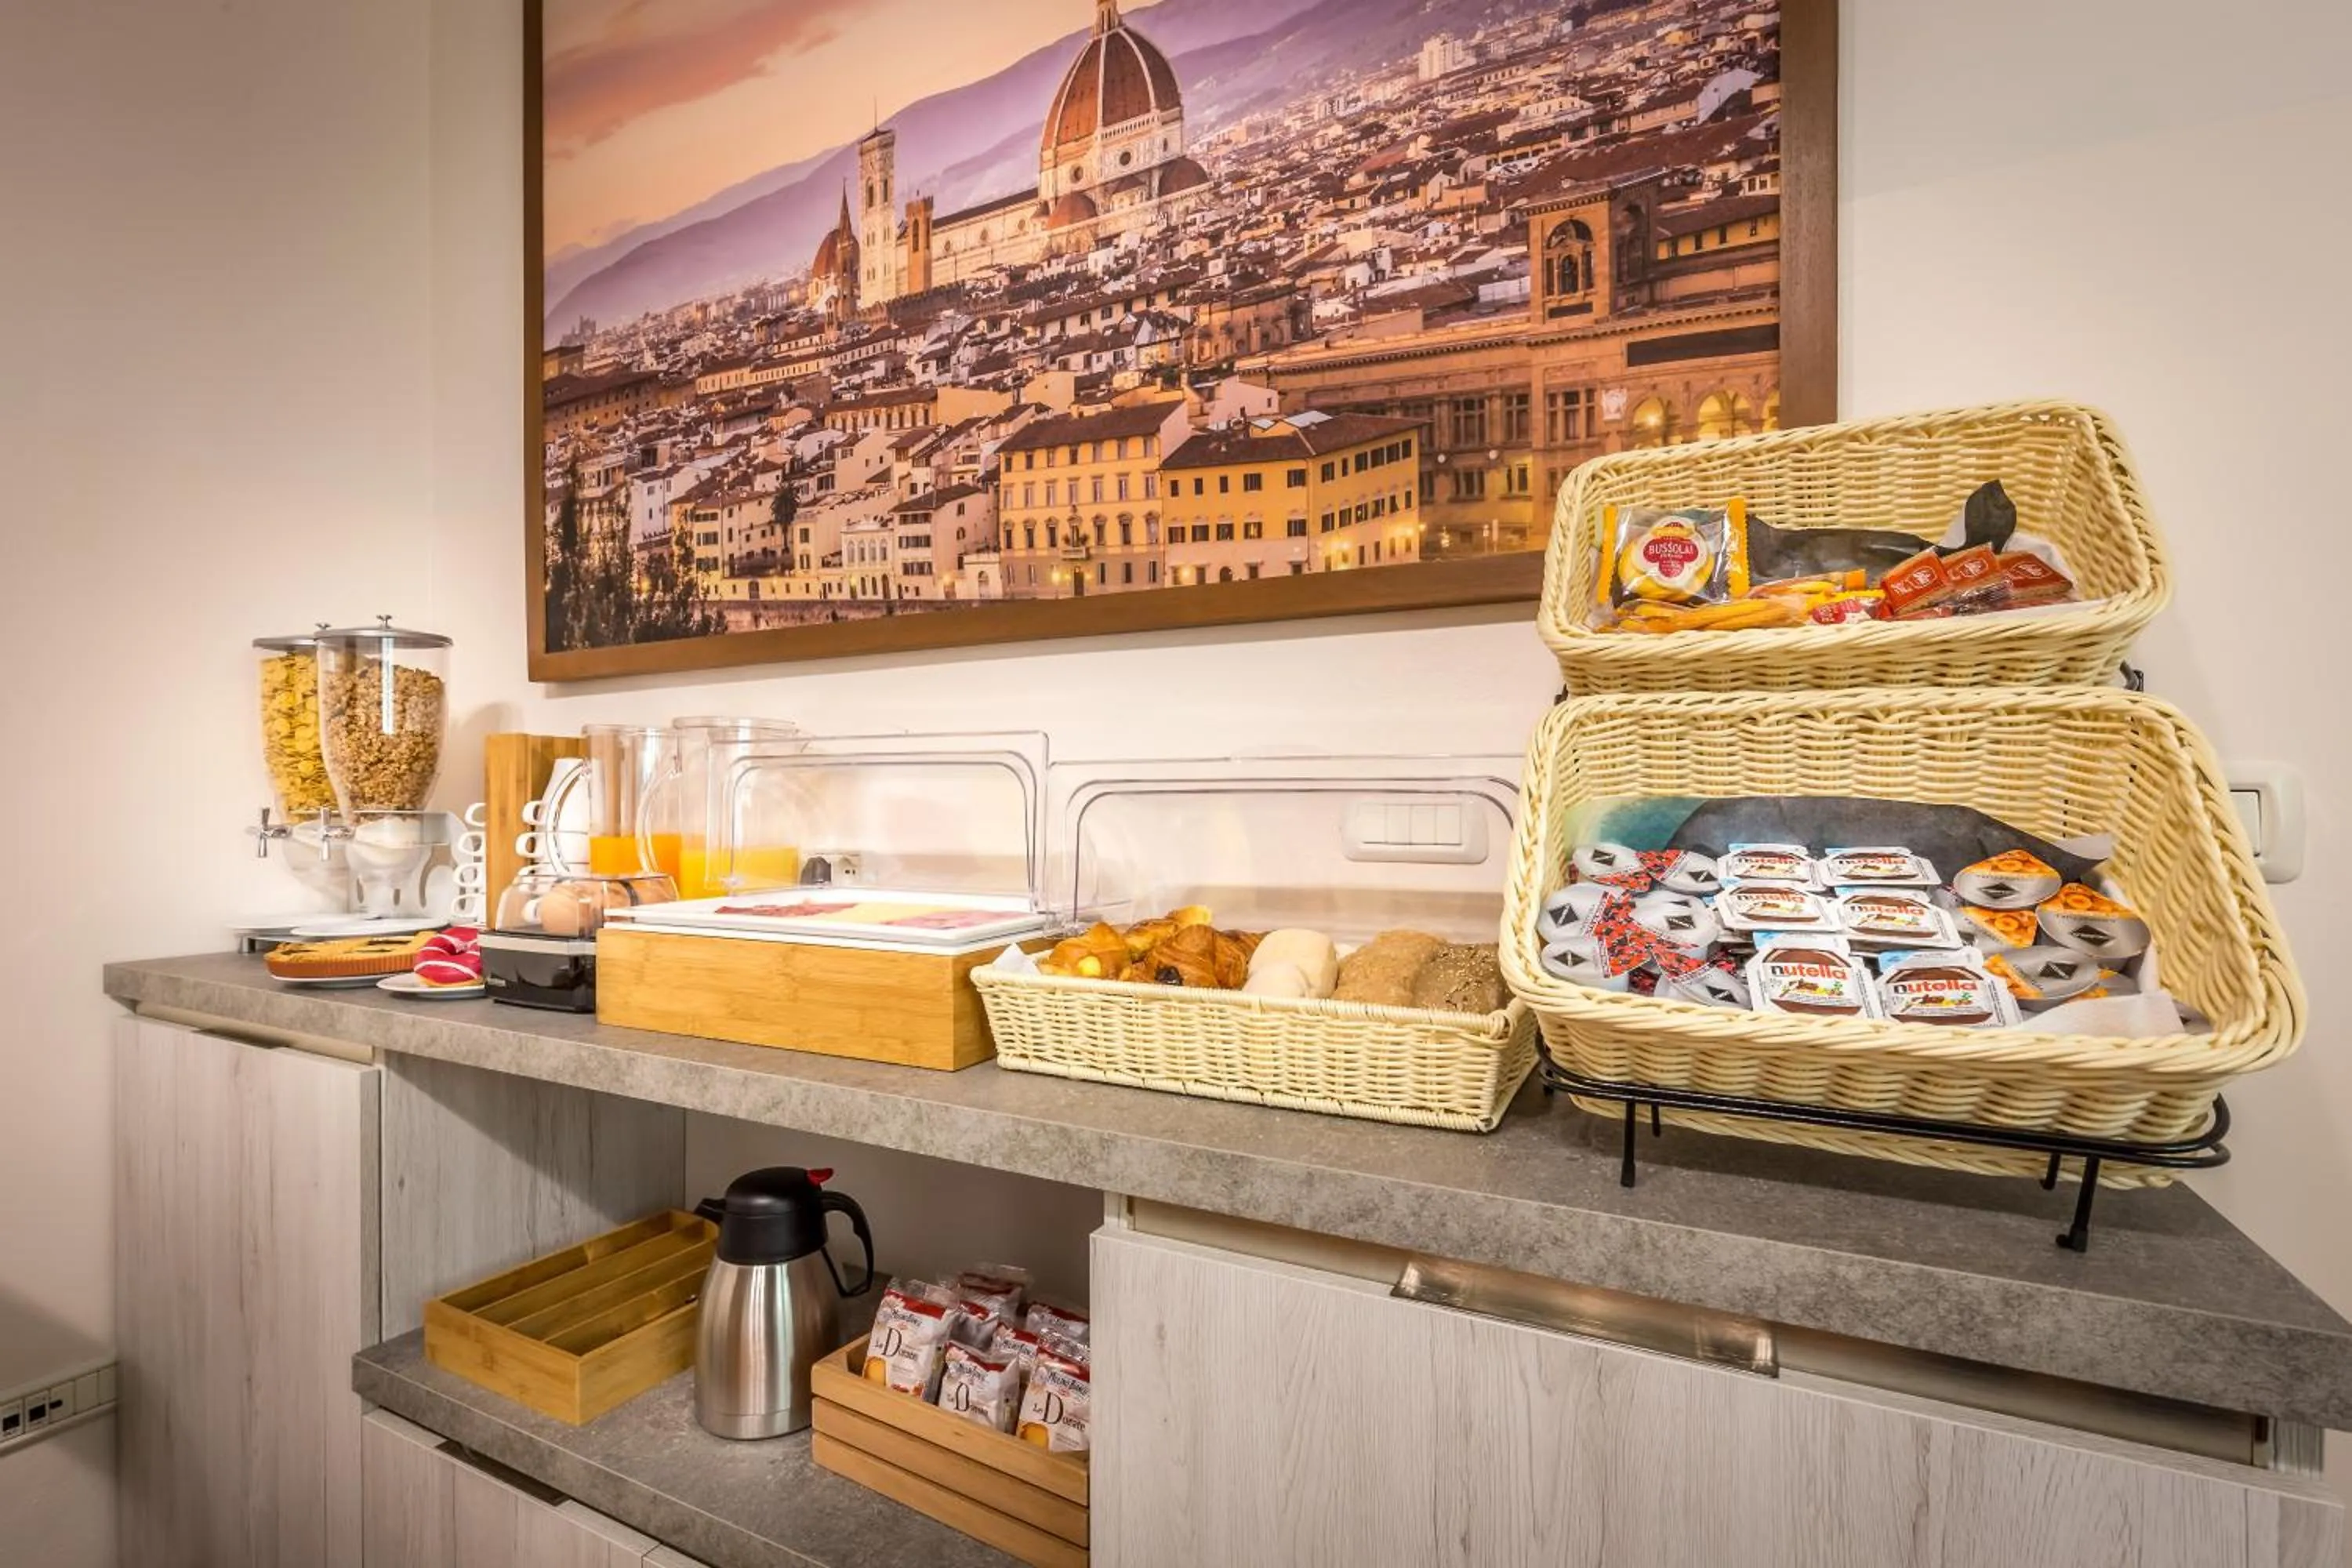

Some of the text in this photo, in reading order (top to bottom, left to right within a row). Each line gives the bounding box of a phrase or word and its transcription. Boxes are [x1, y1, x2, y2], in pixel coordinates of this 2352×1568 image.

[1737, 891, 1805, 903] nutella
[1849, 903, 1925, 916] nutella
[1770, 964, 1848, 980] nutella
[1893, 979, 1978, 994] nutella
